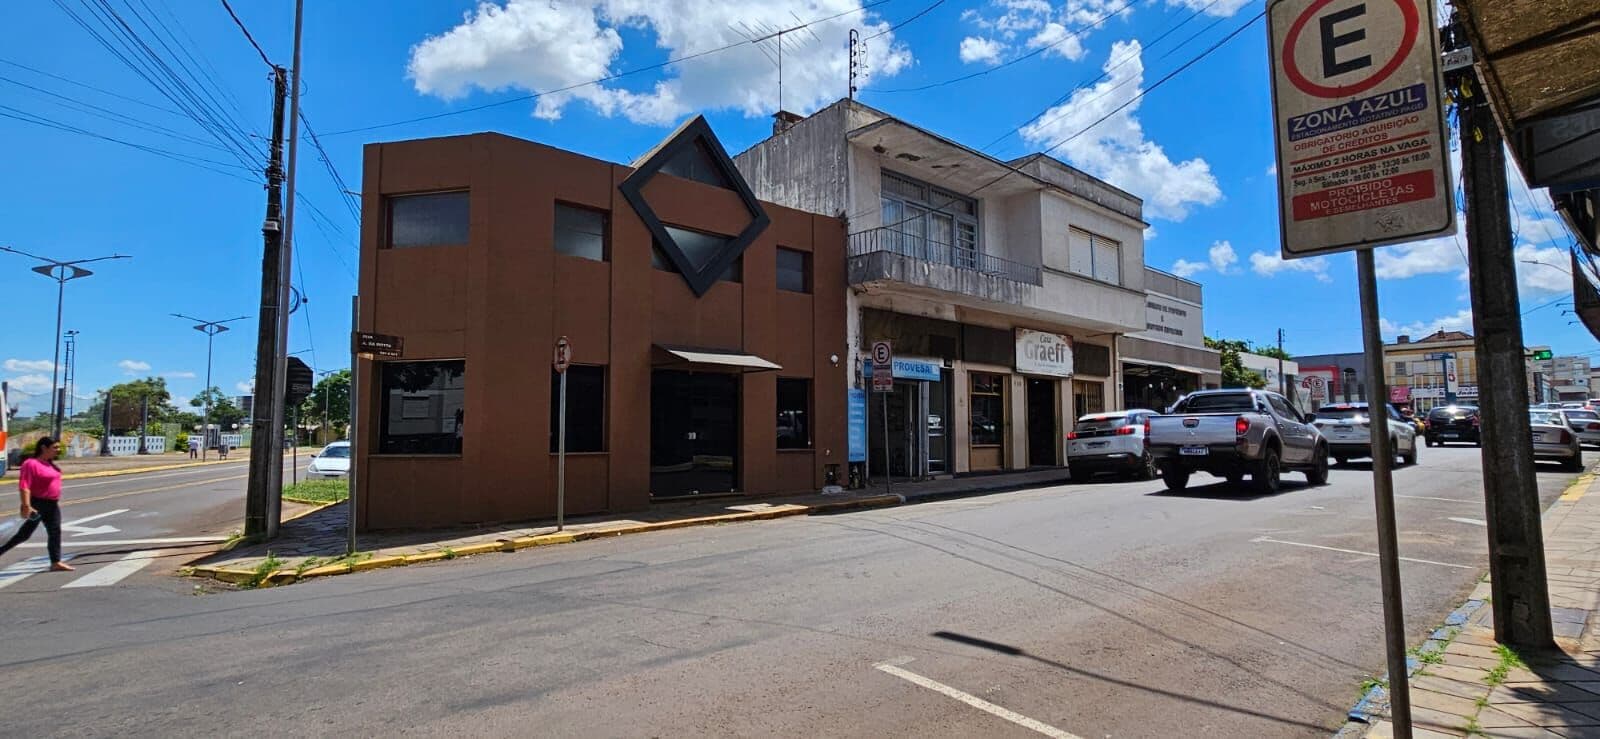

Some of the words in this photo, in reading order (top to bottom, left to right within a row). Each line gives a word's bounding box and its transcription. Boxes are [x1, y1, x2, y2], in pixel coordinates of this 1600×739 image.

[1320, 3, 1372, 78] E
[1293, 105, 1353, 132] ZONA
[1359, 88, 1421, 115] AZUL
[1291, 119, 1359, 140] ESTACIONAMENTO
[1360, 109, 1399, 124] ROTATIVO
[1361, 115, 1420, 135] AQUISIÇÃO
[1293, 159, 1331, 173] MÁXIMO
[1334, 157, 1340, 166] 2
[1341, 150, 1378, 163] HORAS
[1380, 145, 1396, 155] NA
[1397, 138, 1428, 151] VAGA
[1322, 144, 1336, 154] DE
[1310, 184, 1416, 212] MOTOCICLETAS
[1328, 179, 1393, 198] PROIBIDO
[1326, 208, 1333, 216] E
[1335, 196, 1399, 213] SEMELHANTES
[877, 346, 886, 361] E
[1023, 340, 1067, 364] Graeff
